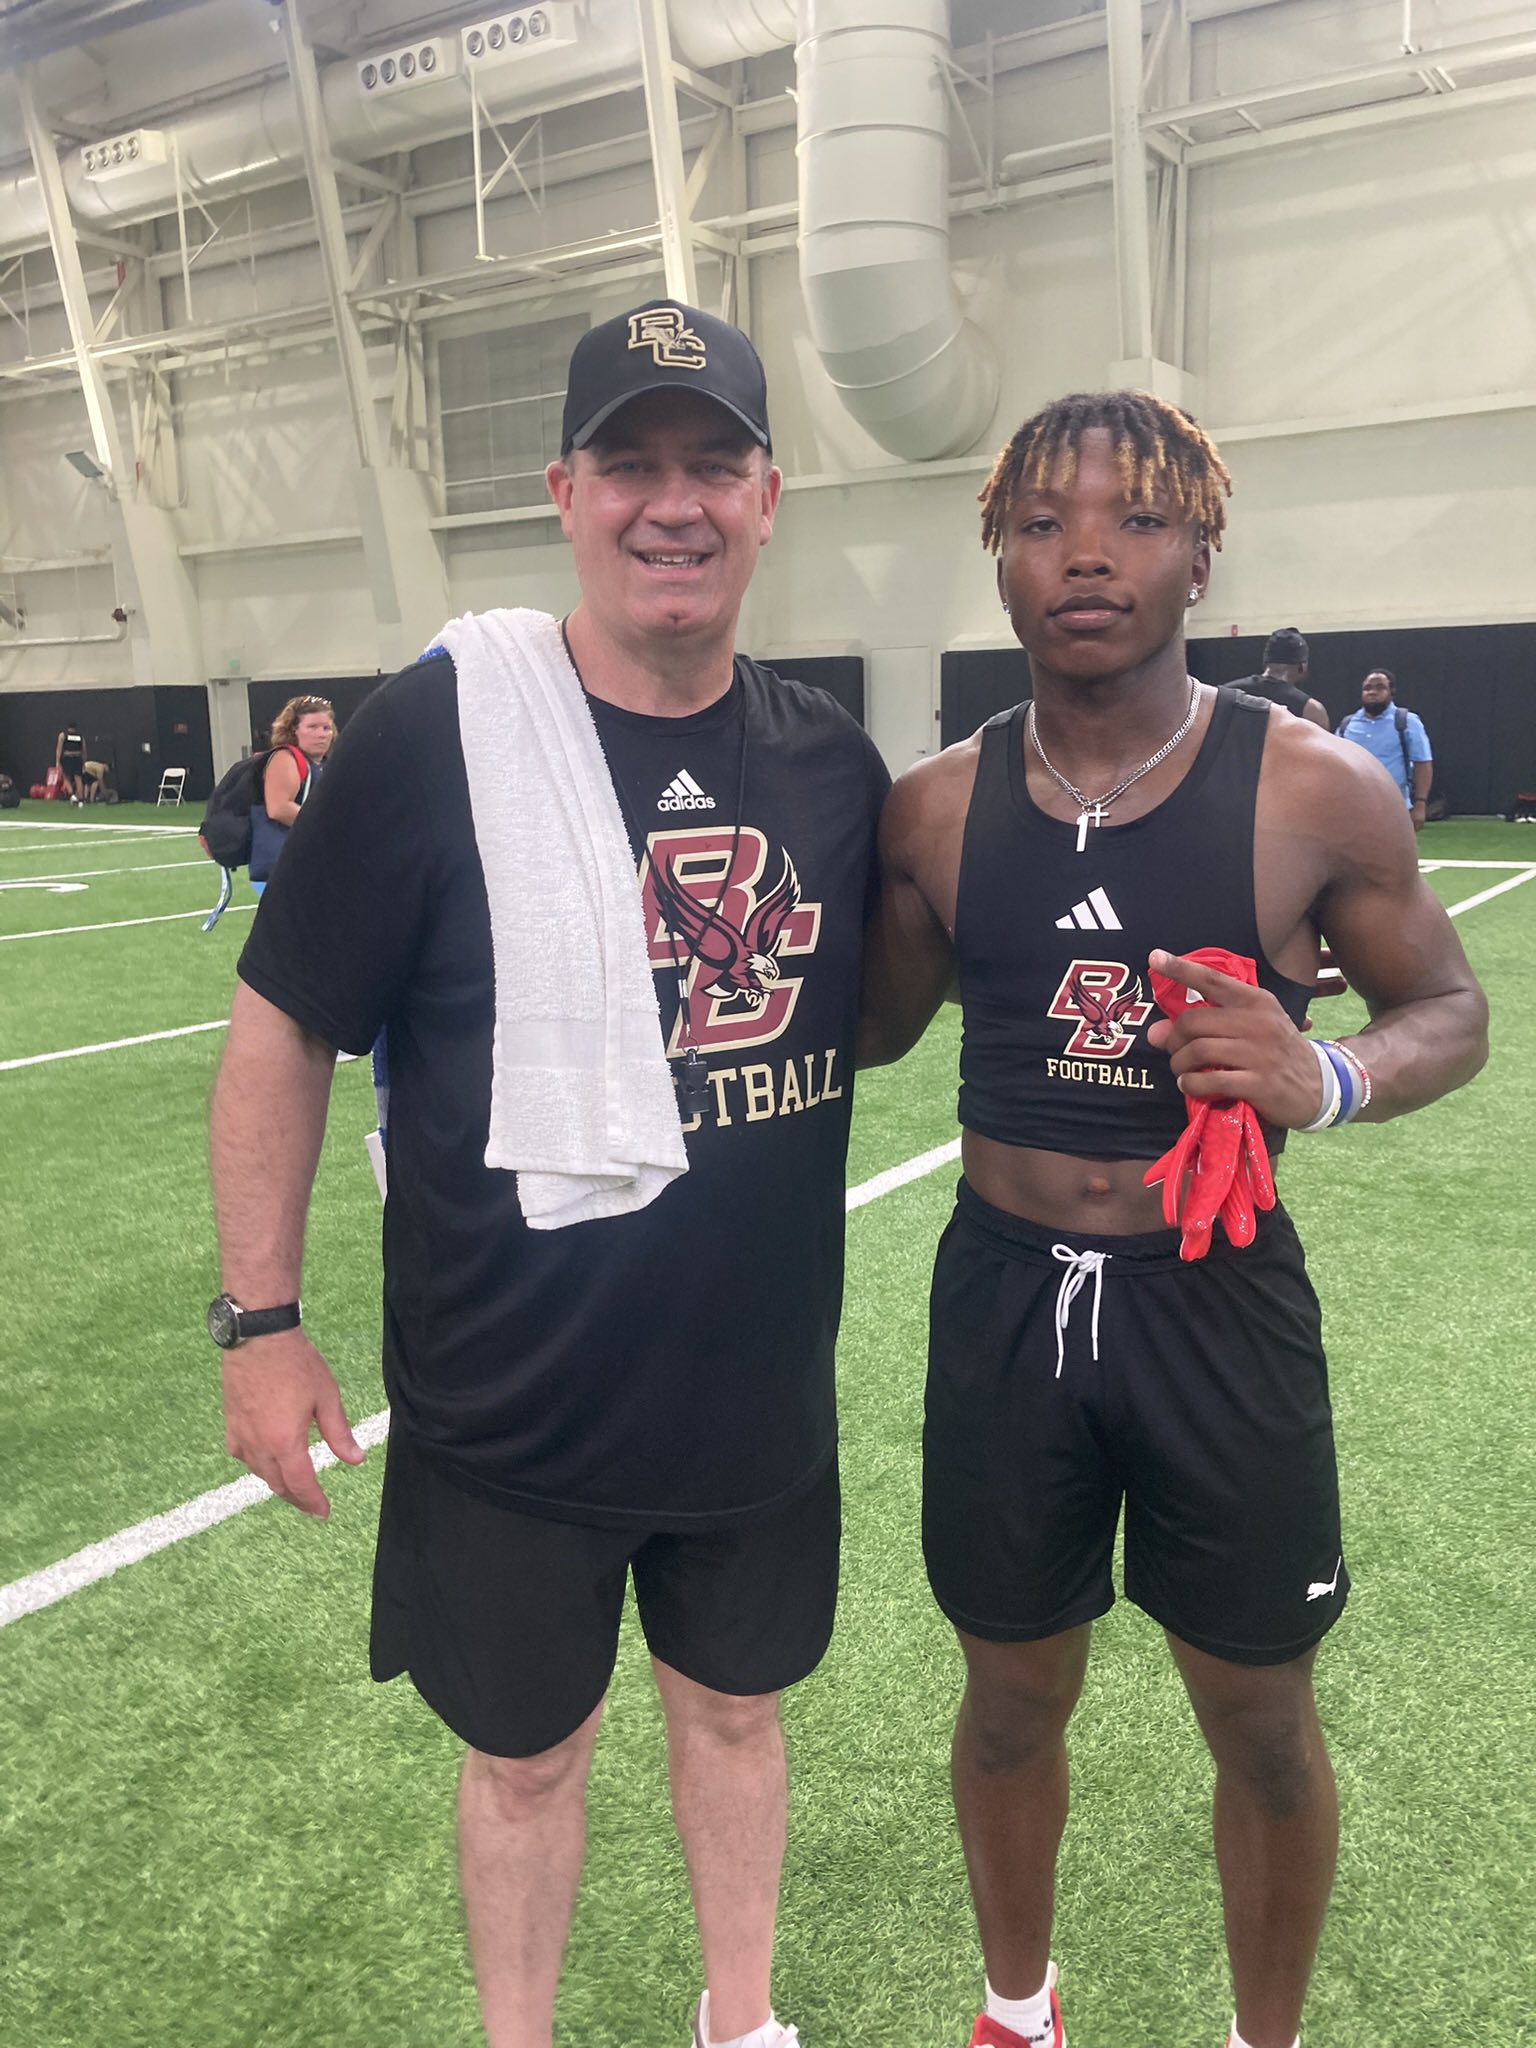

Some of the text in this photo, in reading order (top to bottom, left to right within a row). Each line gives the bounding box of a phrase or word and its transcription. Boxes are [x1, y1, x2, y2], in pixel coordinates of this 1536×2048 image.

[628, 307, 707, 370] BC
[657, 794, 716, 812] adidas
[1046, 959, 1155, 1060] BC
[1046, 1058, 1155, 1090] FOOTBALL
